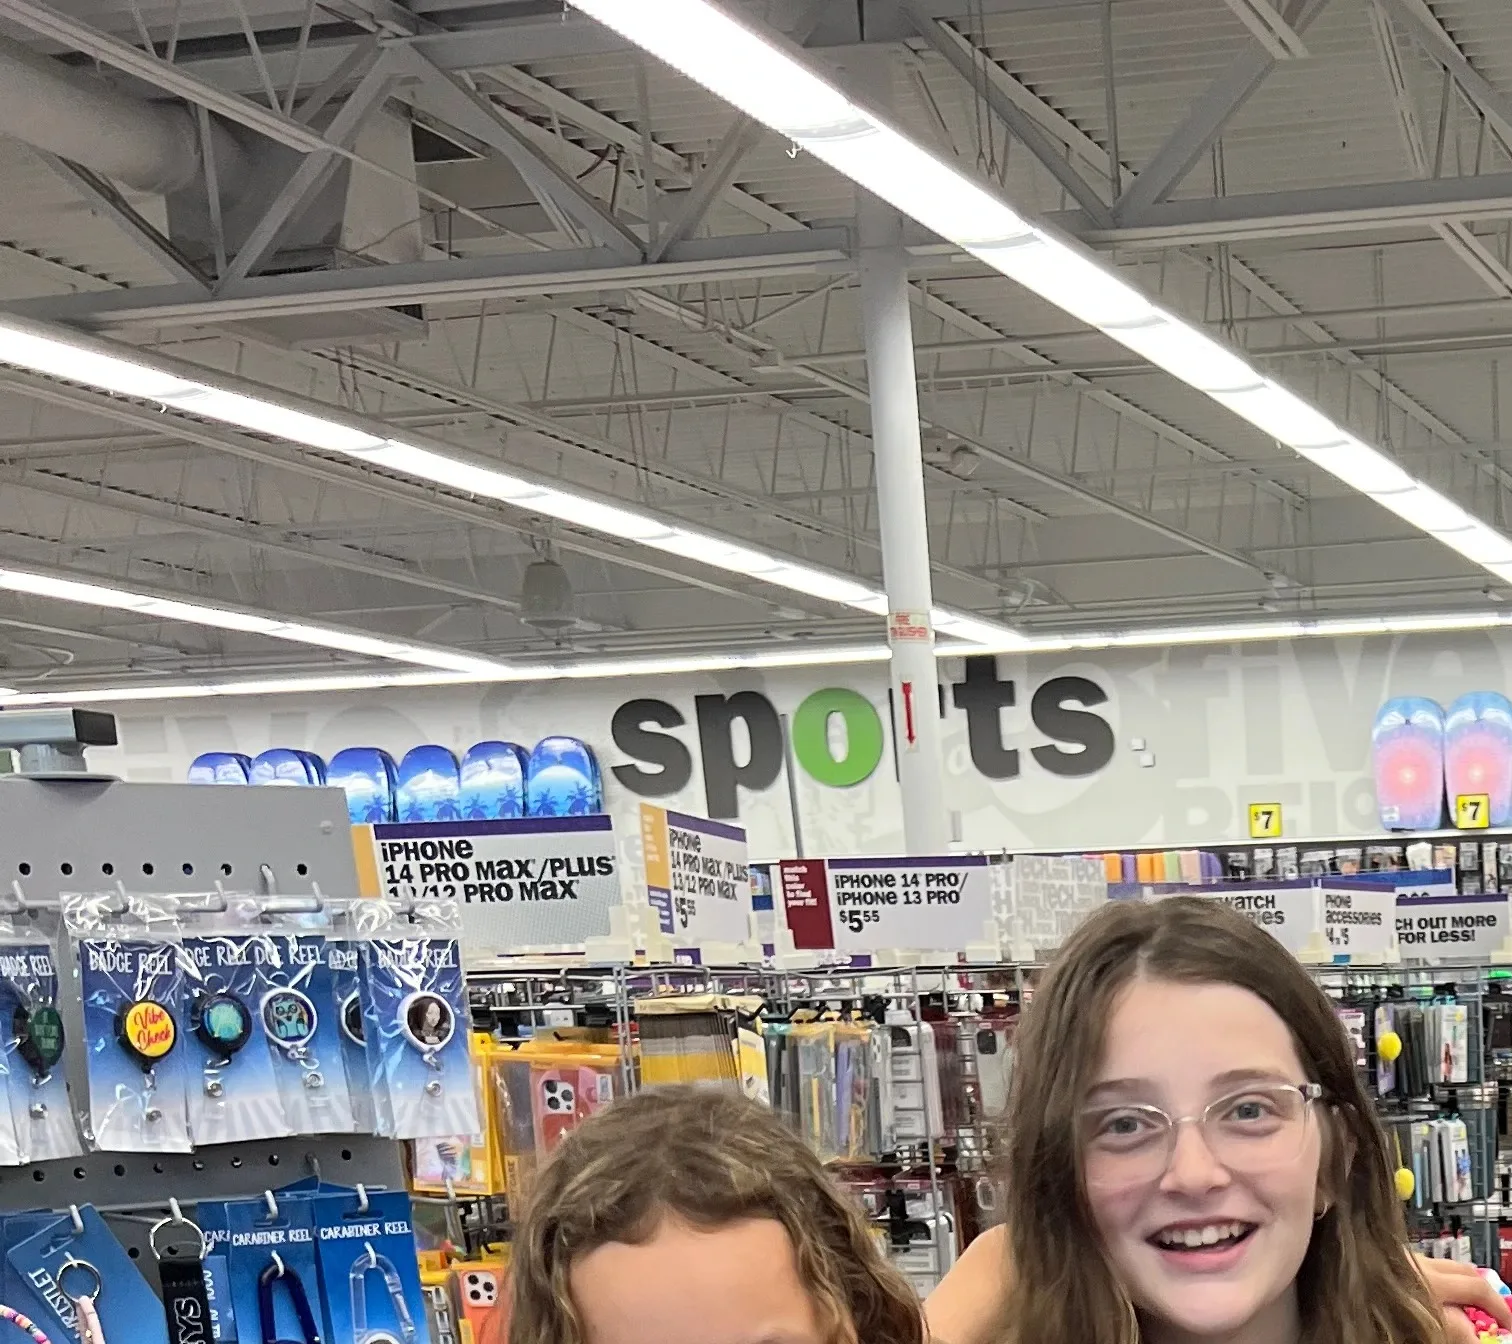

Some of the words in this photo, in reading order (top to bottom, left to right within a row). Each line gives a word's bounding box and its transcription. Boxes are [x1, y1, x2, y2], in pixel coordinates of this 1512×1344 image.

[611, 655, 1116, 820] spots
[385, 863, 413, 884] 14
[420, 862, 470, 882] PRO
[901, 873, 920, 887] 14
[464, 883, 514, 902] PRO
[903, 891, 922, 904] 13
[927, 890, 960, 904] PRO
[1398, 932, 1426, 944] FOR
[89, 950, 133, 974] BADGE
[289, 945, 326, 965] REEL
[134, 1008, 165, 1031] Vibe
[137, 1026, 171, 1049] Check
[232, 1232, 286, 1246] CARABINER
[288, 1229, 313, 1243] REEL
[320, 1226, 381, 1240] CARABINER
[384, 1221, 411, 1235] REEL
[27, 1267, 82, 1340] RISTLET
